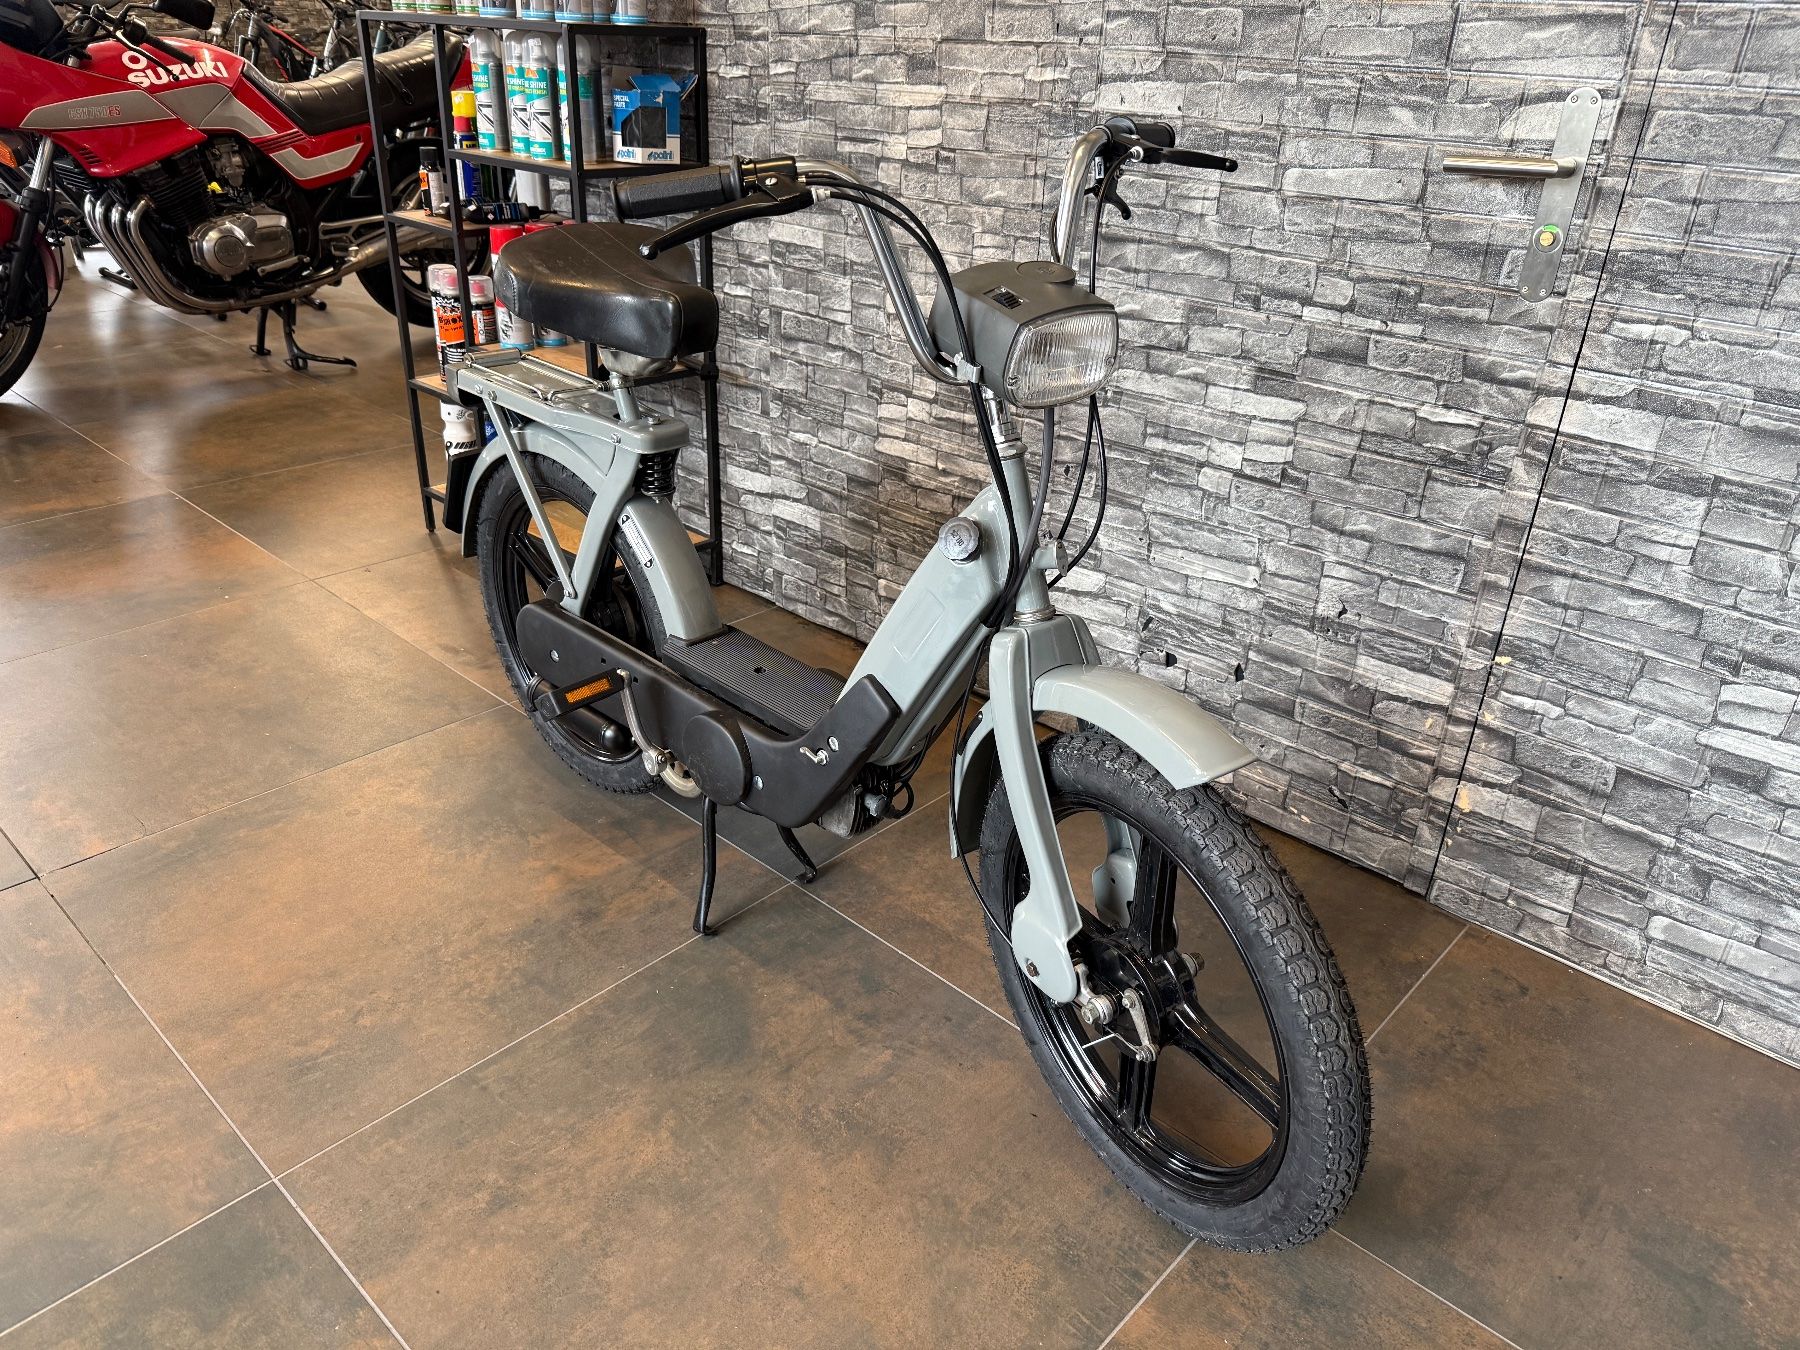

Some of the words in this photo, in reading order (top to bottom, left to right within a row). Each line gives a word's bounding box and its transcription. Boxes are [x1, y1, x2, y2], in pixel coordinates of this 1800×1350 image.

[127, 61, 229, 88] SUZUKI
[530, 81, 547, 89] SHINE
[653, 150, 673, 160] polini
